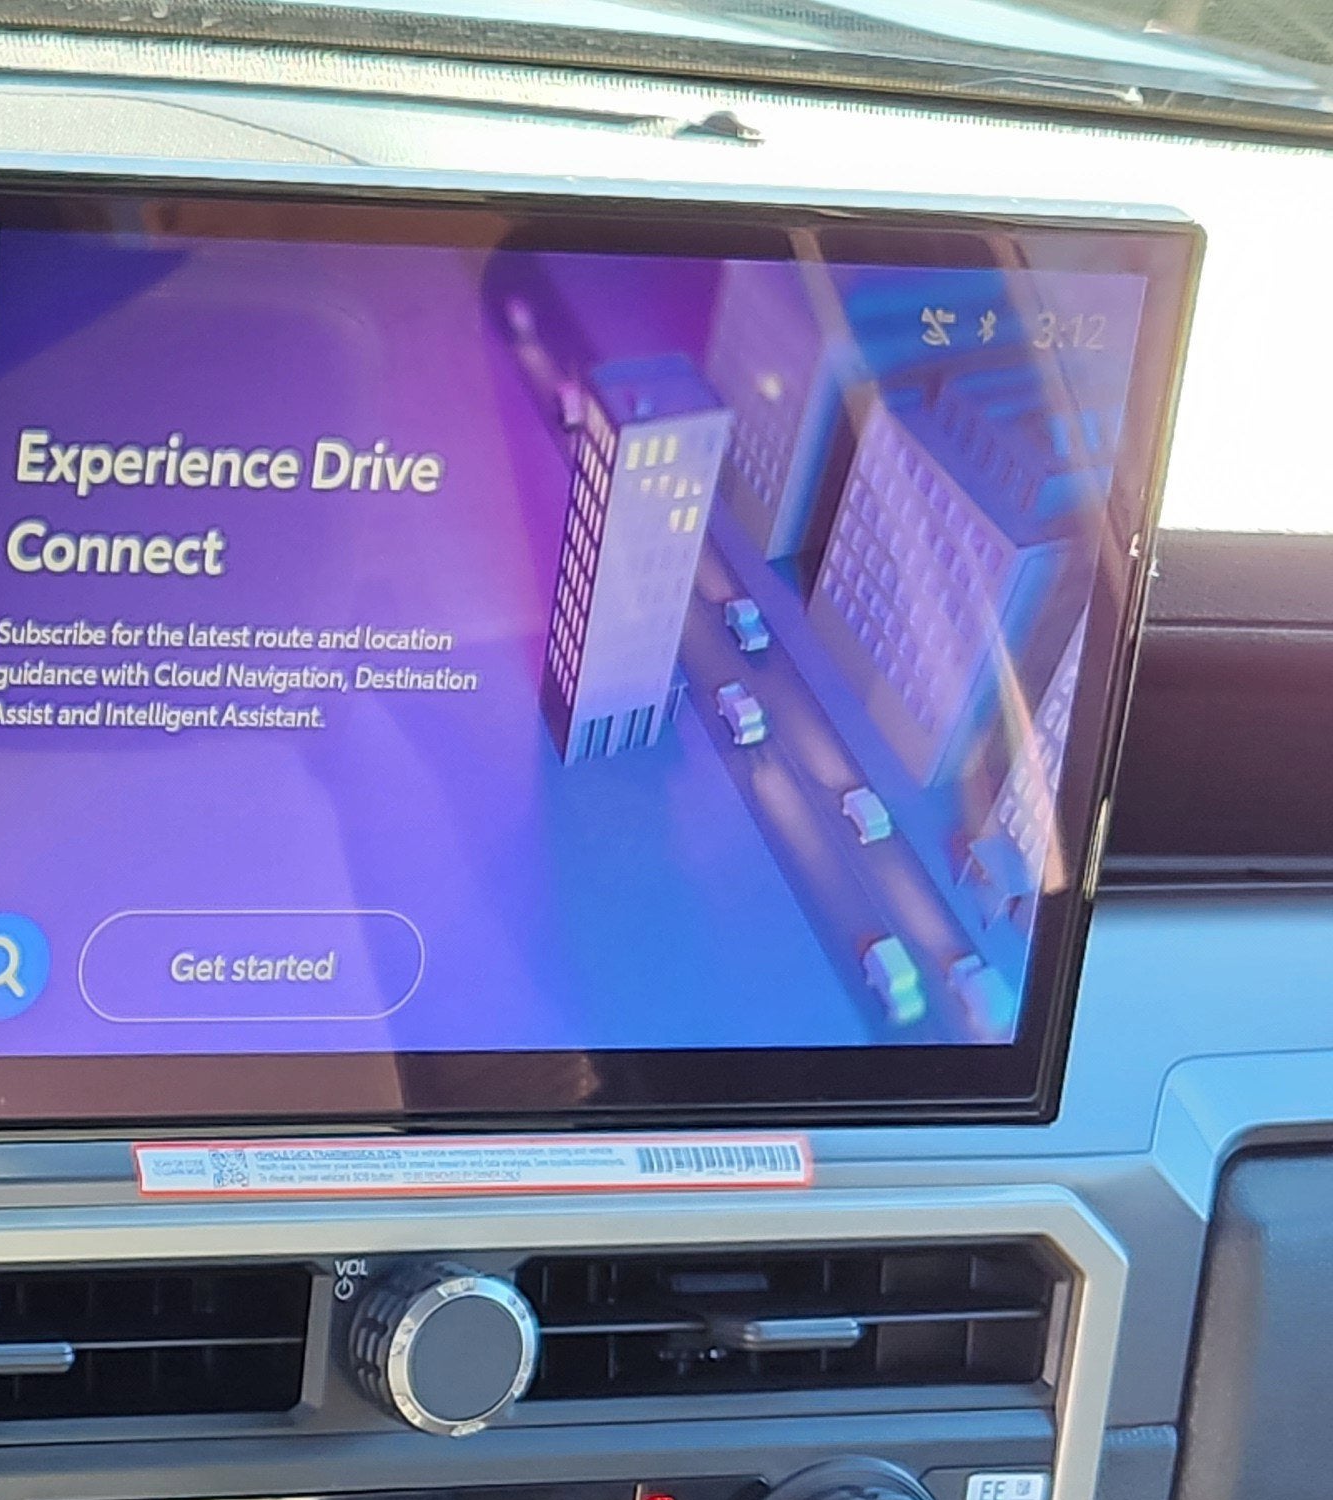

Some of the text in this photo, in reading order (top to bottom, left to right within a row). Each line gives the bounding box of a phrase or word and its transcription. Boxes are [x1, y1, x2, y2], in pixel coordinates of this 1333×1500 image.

[1033, 310, 1106, 351] 3:12
[16, 429, 442, 495] Experience Drive
[6, 520, 224, 576] Connect
[111, 623, 142, 647] for
[147, 624, 183, 648] the
[188, 624, 250, 649] latest
[254, 629, 313, 650] route
[318, 627, 359, 650] and
[365, 627, 453, 651] location
[101, 663, 149, 687] with
[154, 663, 221, 688] Cloud
[226, 665, 348, 693] Navigation,
[354, 666, 478, 691] Destination
[57, 702, 100, 726] and
[105, 702, 218, 732] Intelligent
[220, 703, 325, 729] Assistant.
[170, 951, 335, 982] Get started
[335, 1260, 367, 1277] VOL
